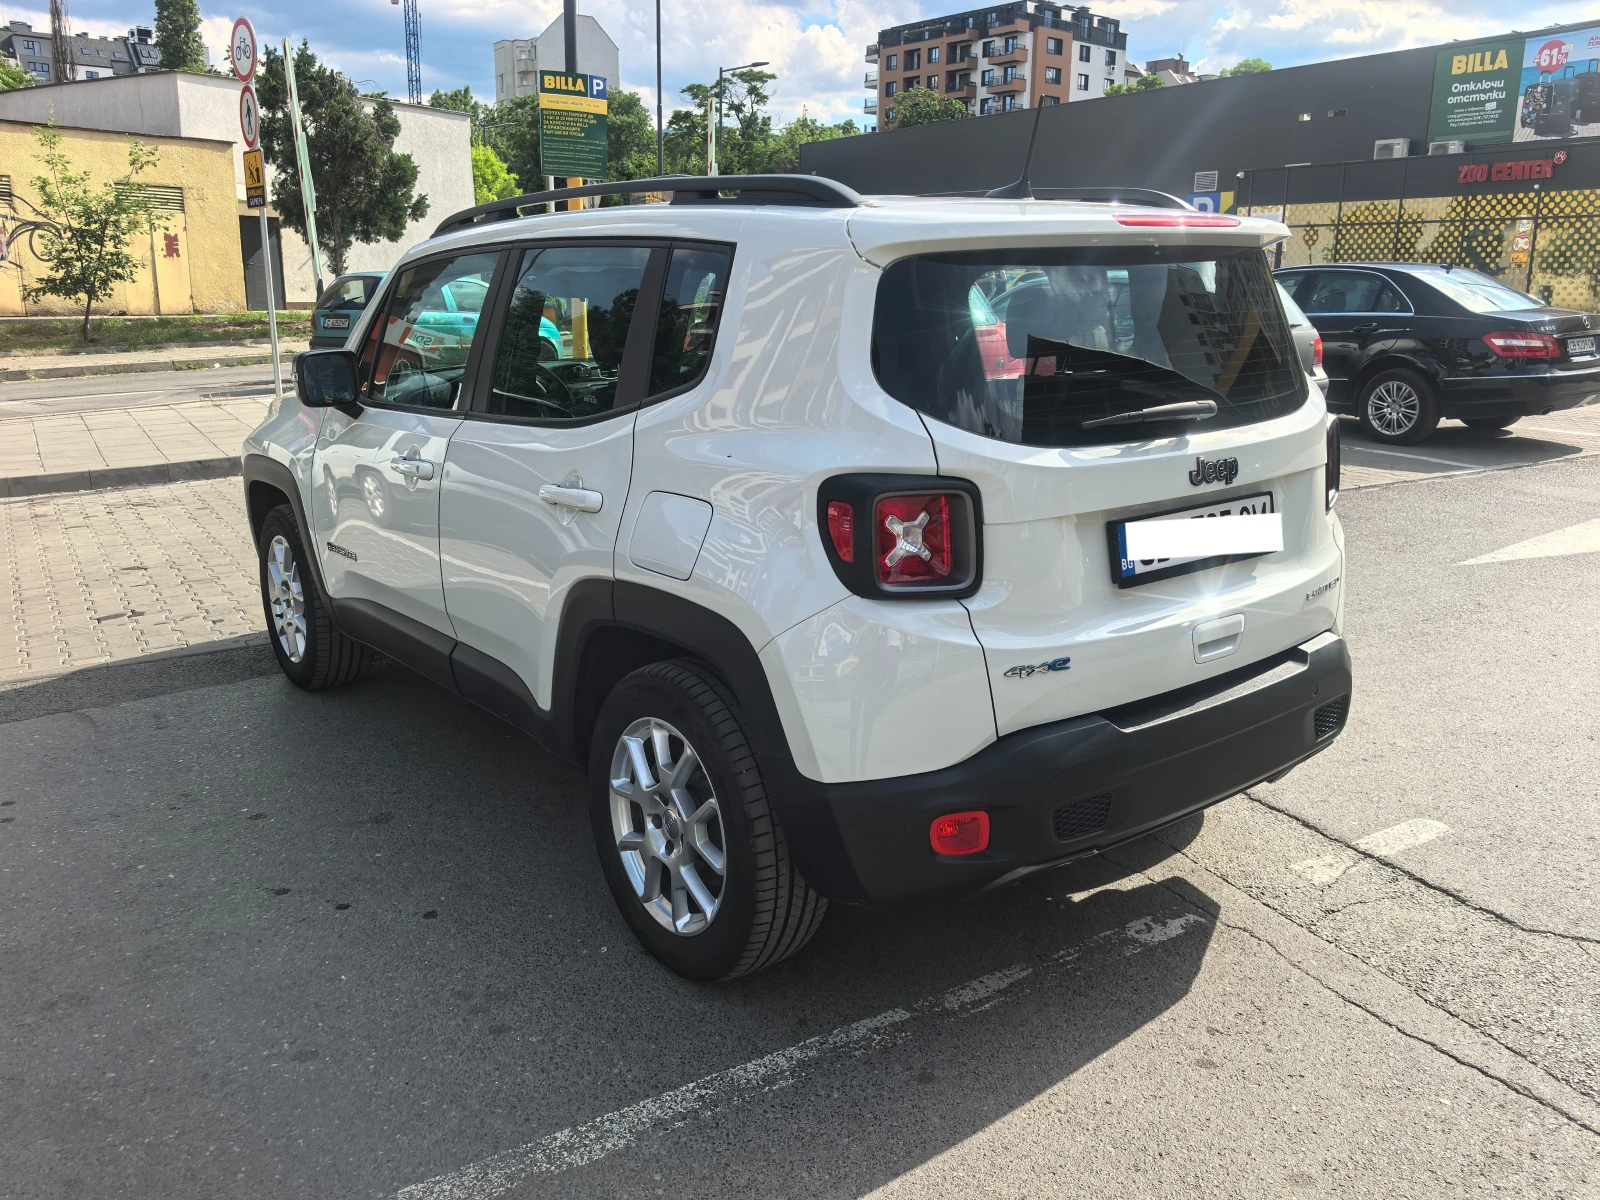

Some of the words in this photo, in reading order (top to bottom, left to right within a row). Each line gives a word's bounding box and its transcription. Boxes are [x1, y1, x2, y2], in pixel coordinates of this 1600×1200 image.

[1451, 49, 1508, 75] BILLA
[544, 75, 585, 92] BILLA
[593, 79, 604, 95] P
[1451, 80, 1504, 93] Отключи
[1447, 90, 1506, 104] отстъпки
[1457, 164, 1488, 183] ZOO
[1491, 160, 1553, 182] CENTER
[1189, 456, 1239, 486] Jeep
[1121, 558, 1134, 571] BG
